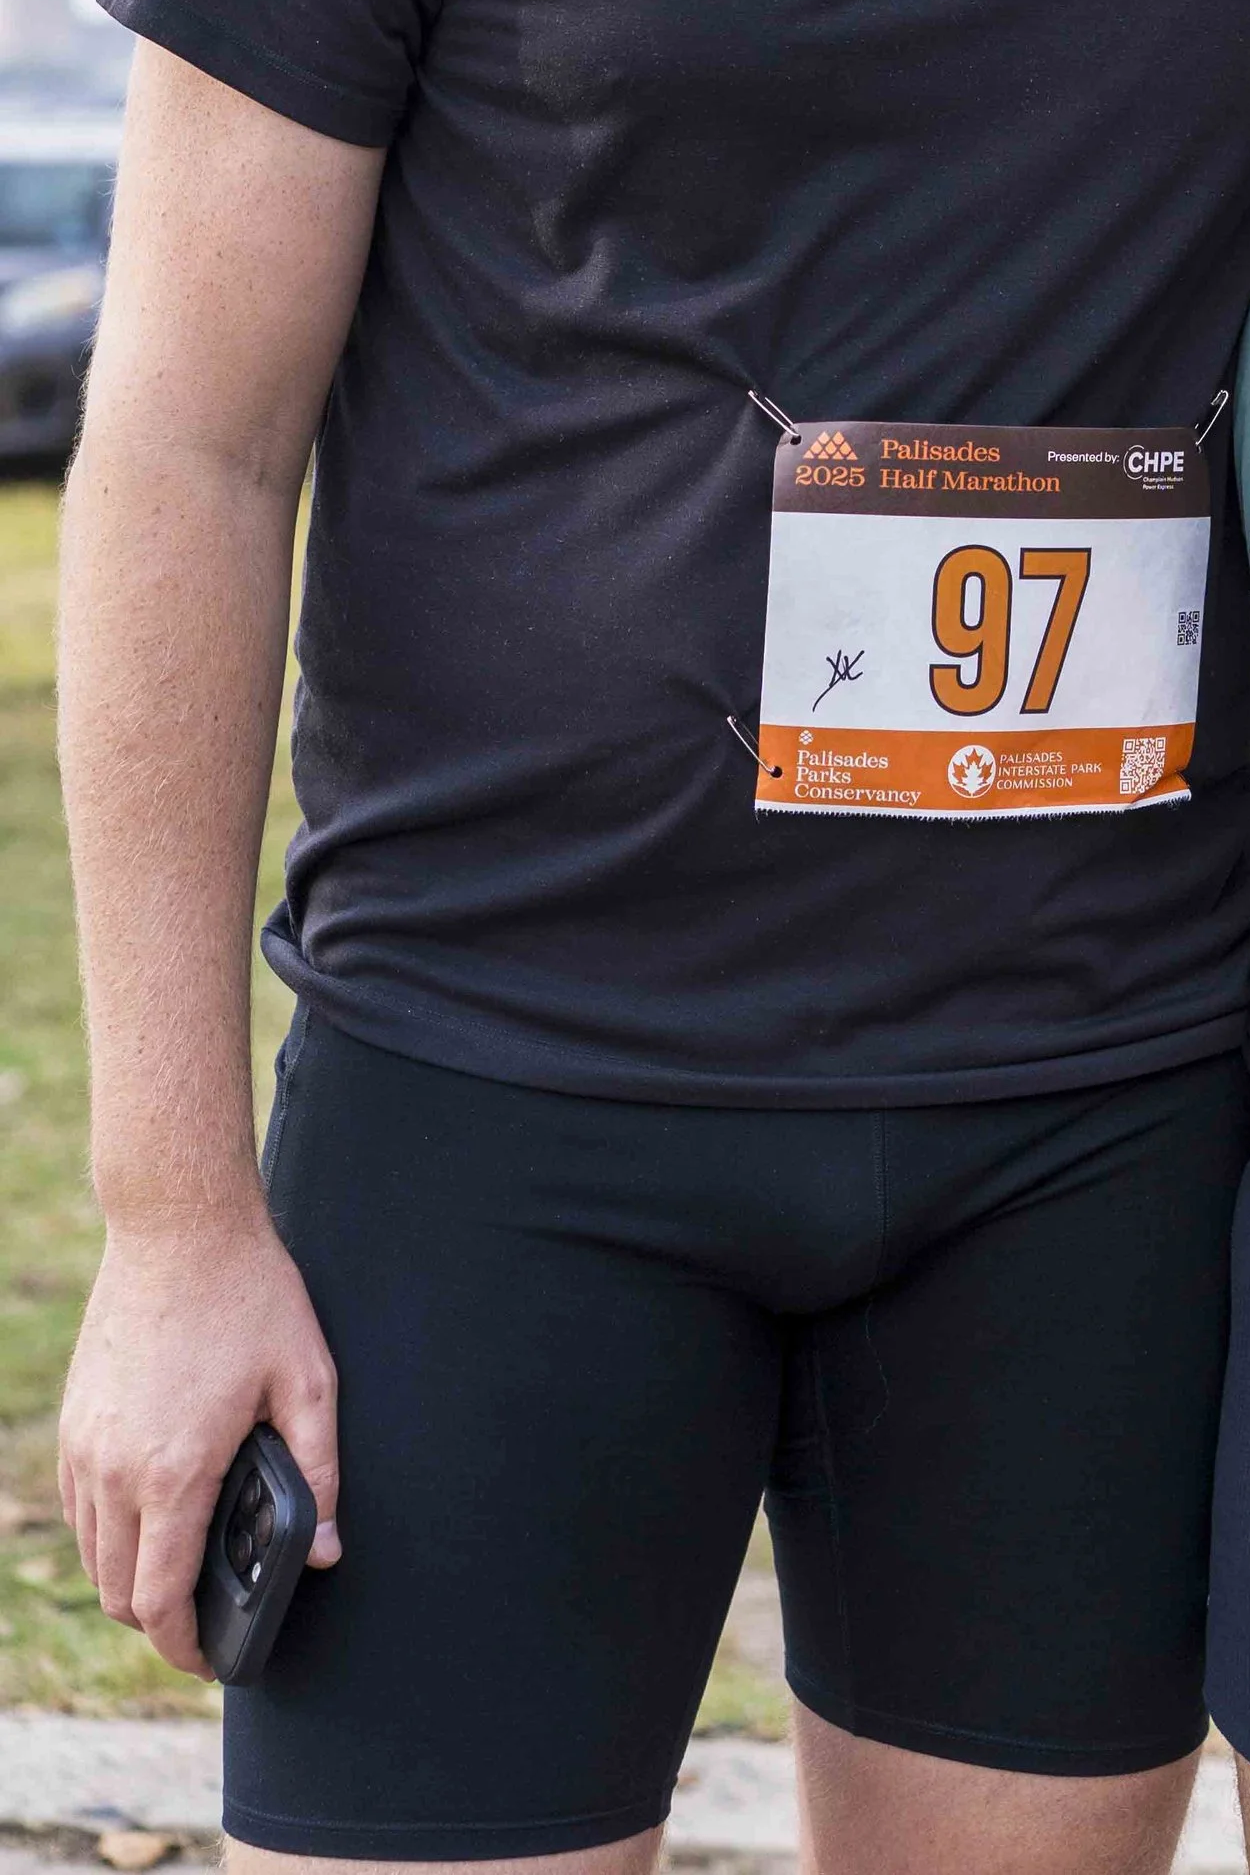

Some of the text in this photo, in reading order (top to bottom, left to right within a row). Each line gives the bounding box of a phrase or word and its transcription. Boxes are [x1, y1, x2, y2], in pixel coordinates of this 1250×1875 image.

[881, 439, 1000, 463] Palisades
[1048, 451, 1120, 464] Presented by:
[1127, 451, 1185, 473] CHPE
[795, 465, 865, 487] 2025
[879, 469, 1061, 493] Half Marathon
[929, 544, 1092, 717] 97
[797, 749, 889, 768] Palisades
[1000, 751, 1063, 764] PALISADES
[796, 766, 851, 784] Parks
[998, 763, 1102, 777] INTERSTATE PARK
[996, 777, 1073, 790] COMMISSION
[794, 783, 921, 806] Conservancy
